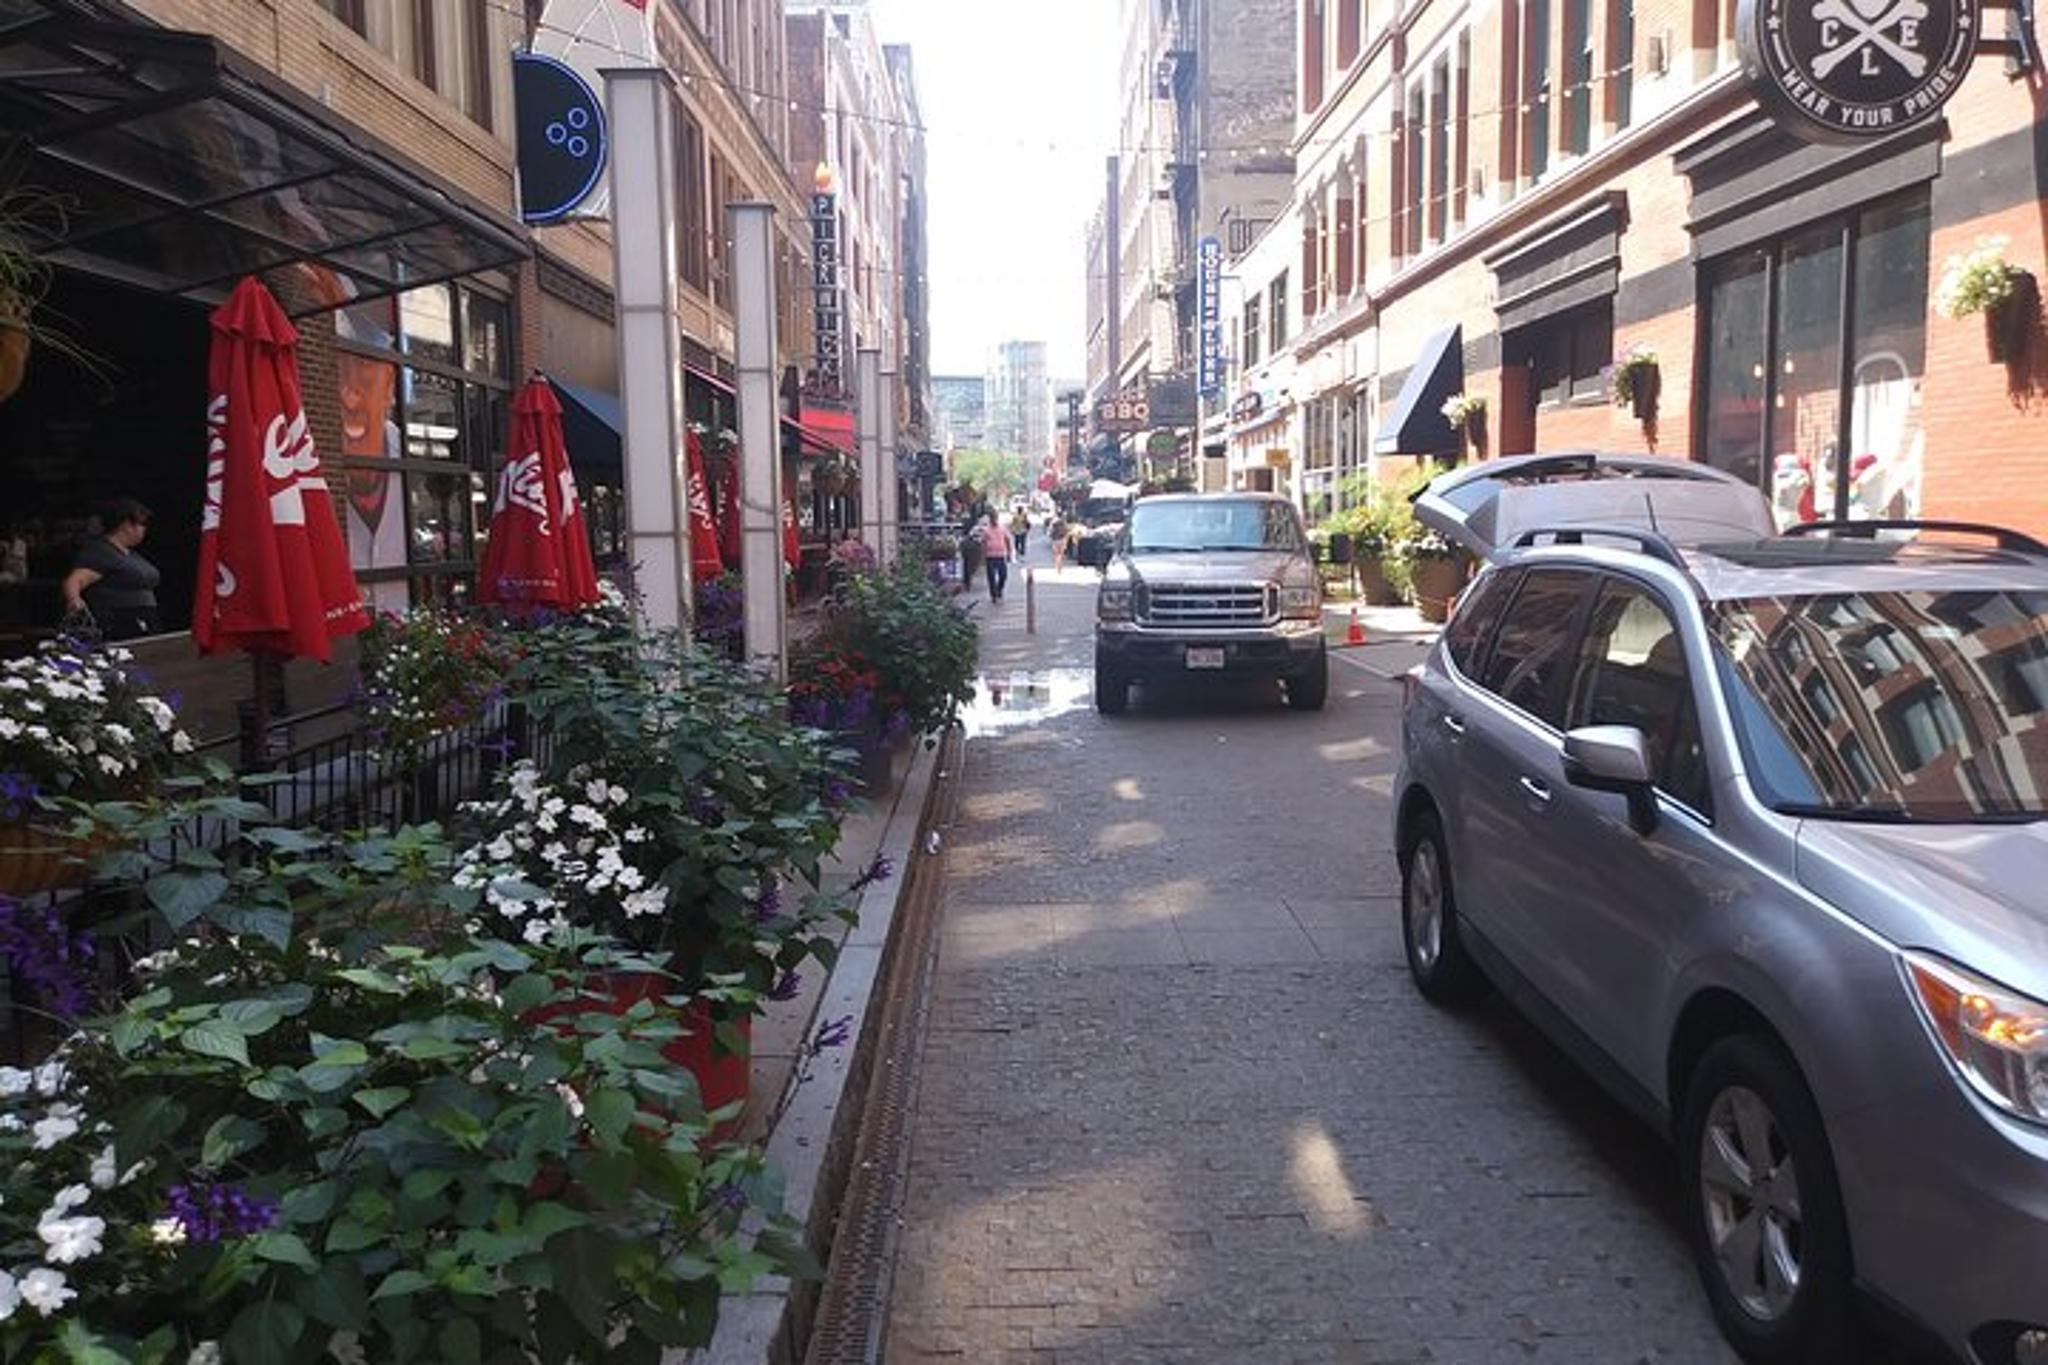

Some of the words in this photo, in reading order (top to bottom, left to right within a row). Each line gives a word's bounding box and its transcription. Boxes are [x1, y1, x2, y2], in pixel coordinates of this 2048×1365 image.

[1782, 69, 1830, 116] WEAR
[1841, 106, 1893, 126] YOUR
[1904, 66, 1955, 116] PRIDE
